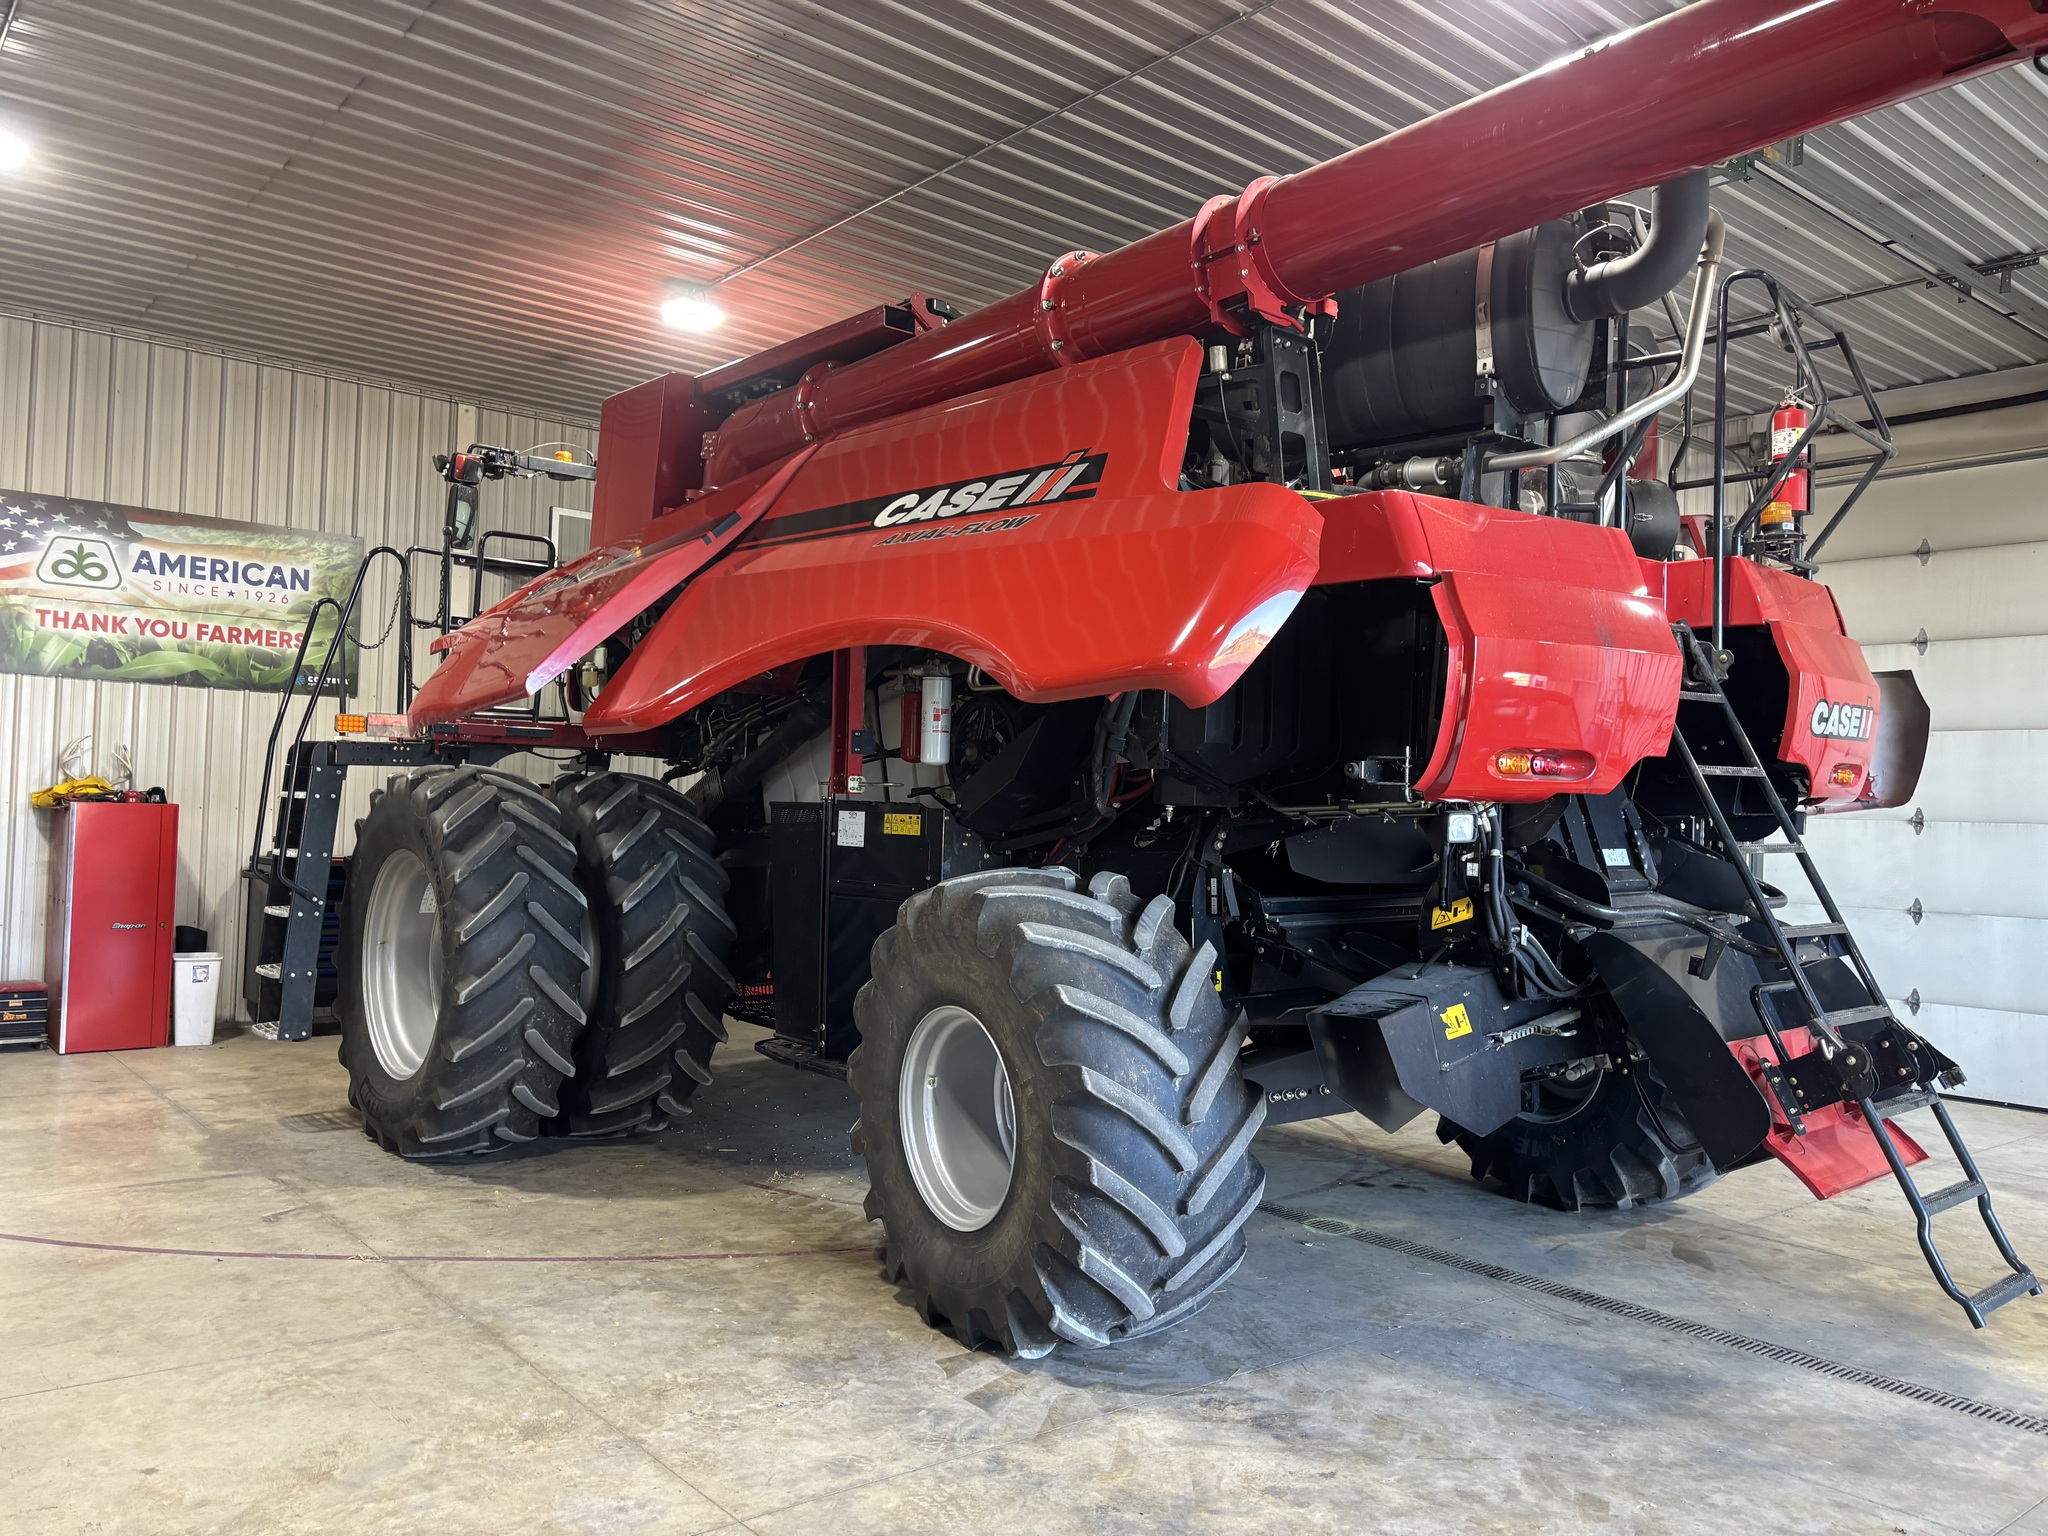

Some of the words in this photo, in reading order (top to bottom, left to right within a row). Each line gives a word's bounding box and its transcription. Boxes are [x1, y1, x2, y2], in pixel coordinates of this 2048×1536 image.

[873, 473, 1031, 529] CASE
[872, 513, 1042, 548] AXIAL-FLOW
[131, 550, 310, 592] AMERICAN
[153, 580, 219, 598] SINCE
[244, 589, 290, 605] 1926
[35, 608, 128, 635] THANK
[134, 617, 188, 639] YOU
[1811, 701, 1862, 738] CASE
